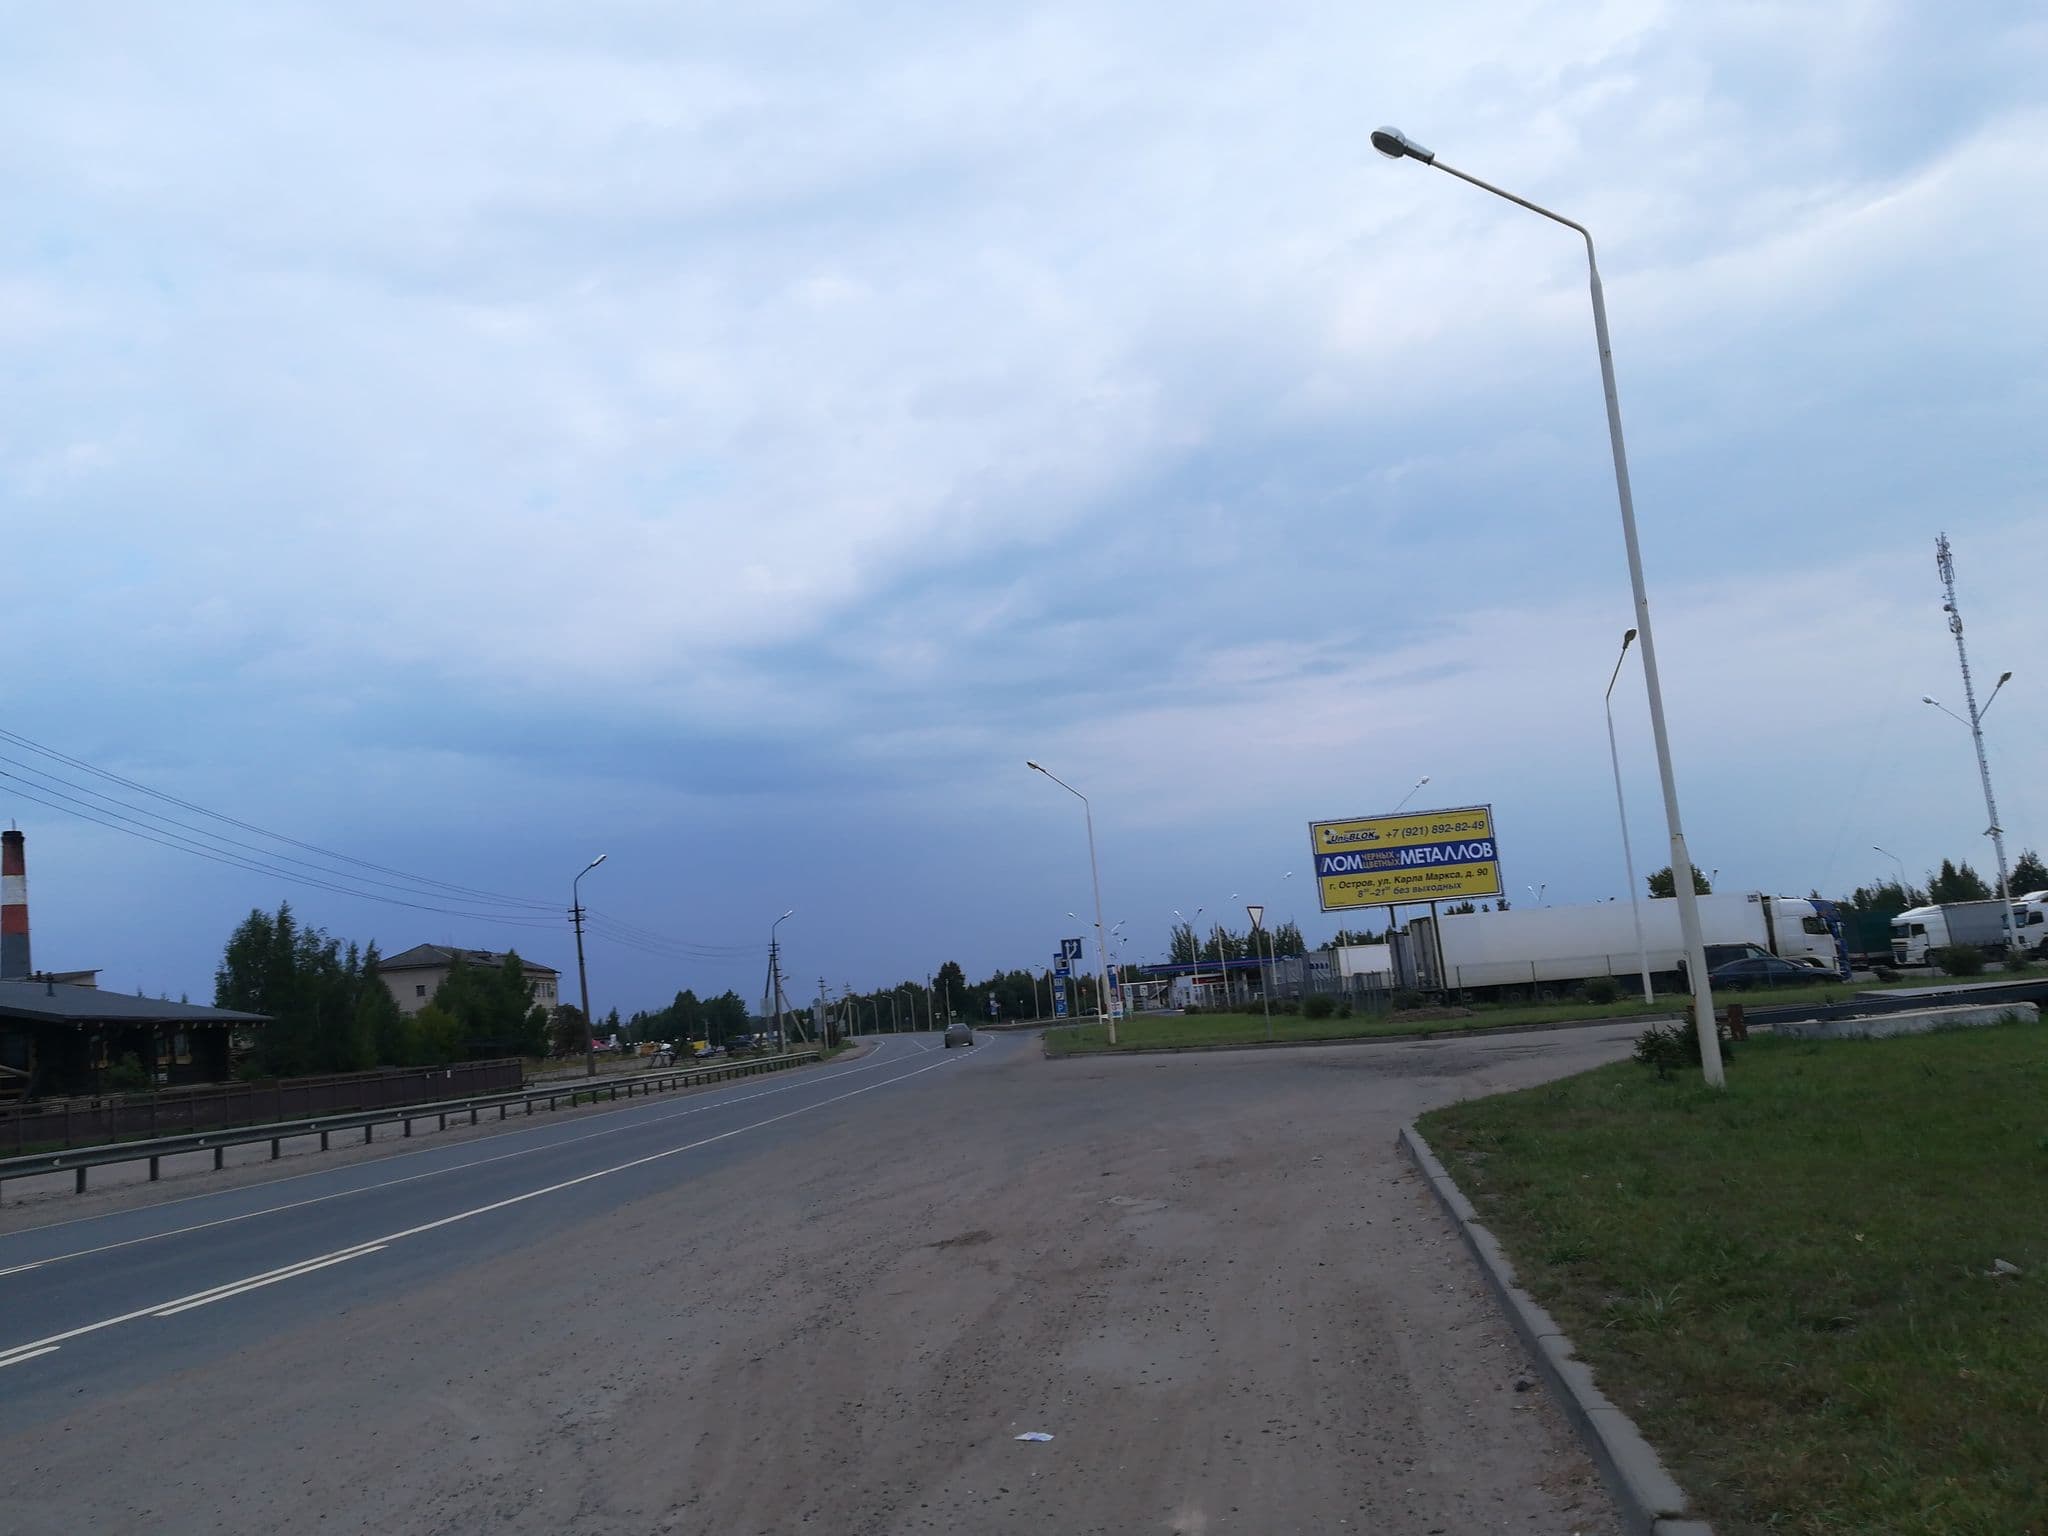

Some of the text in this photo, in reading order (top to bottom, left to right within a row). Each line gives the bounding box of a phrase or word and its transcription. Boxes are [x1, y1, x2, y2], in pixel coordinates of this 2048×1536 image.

[1386, 820, 1485, 839] +7 (921) 892-82-49
[1323, 854, 1363, 873] ЛОМ
[1361, 850, 1395, 861] ЧЕРНЫХ
[1362, 858, 1401, 869] ЦВЕТНЫХ
[1400, 842, 1493, 866] МЕТАЛЛОВ
[1378, 878, 1391, 886] ул.
[1394, 874, 1423, 884] Карла
[1425, 871, 1463, 882] Маркса,
[1465, 870, 1474, 879] д.
[1477, 867, 1488, 877] 90
[1393, 886, 1409, 895] без
[1412, 882, 1462, 894] выходных
